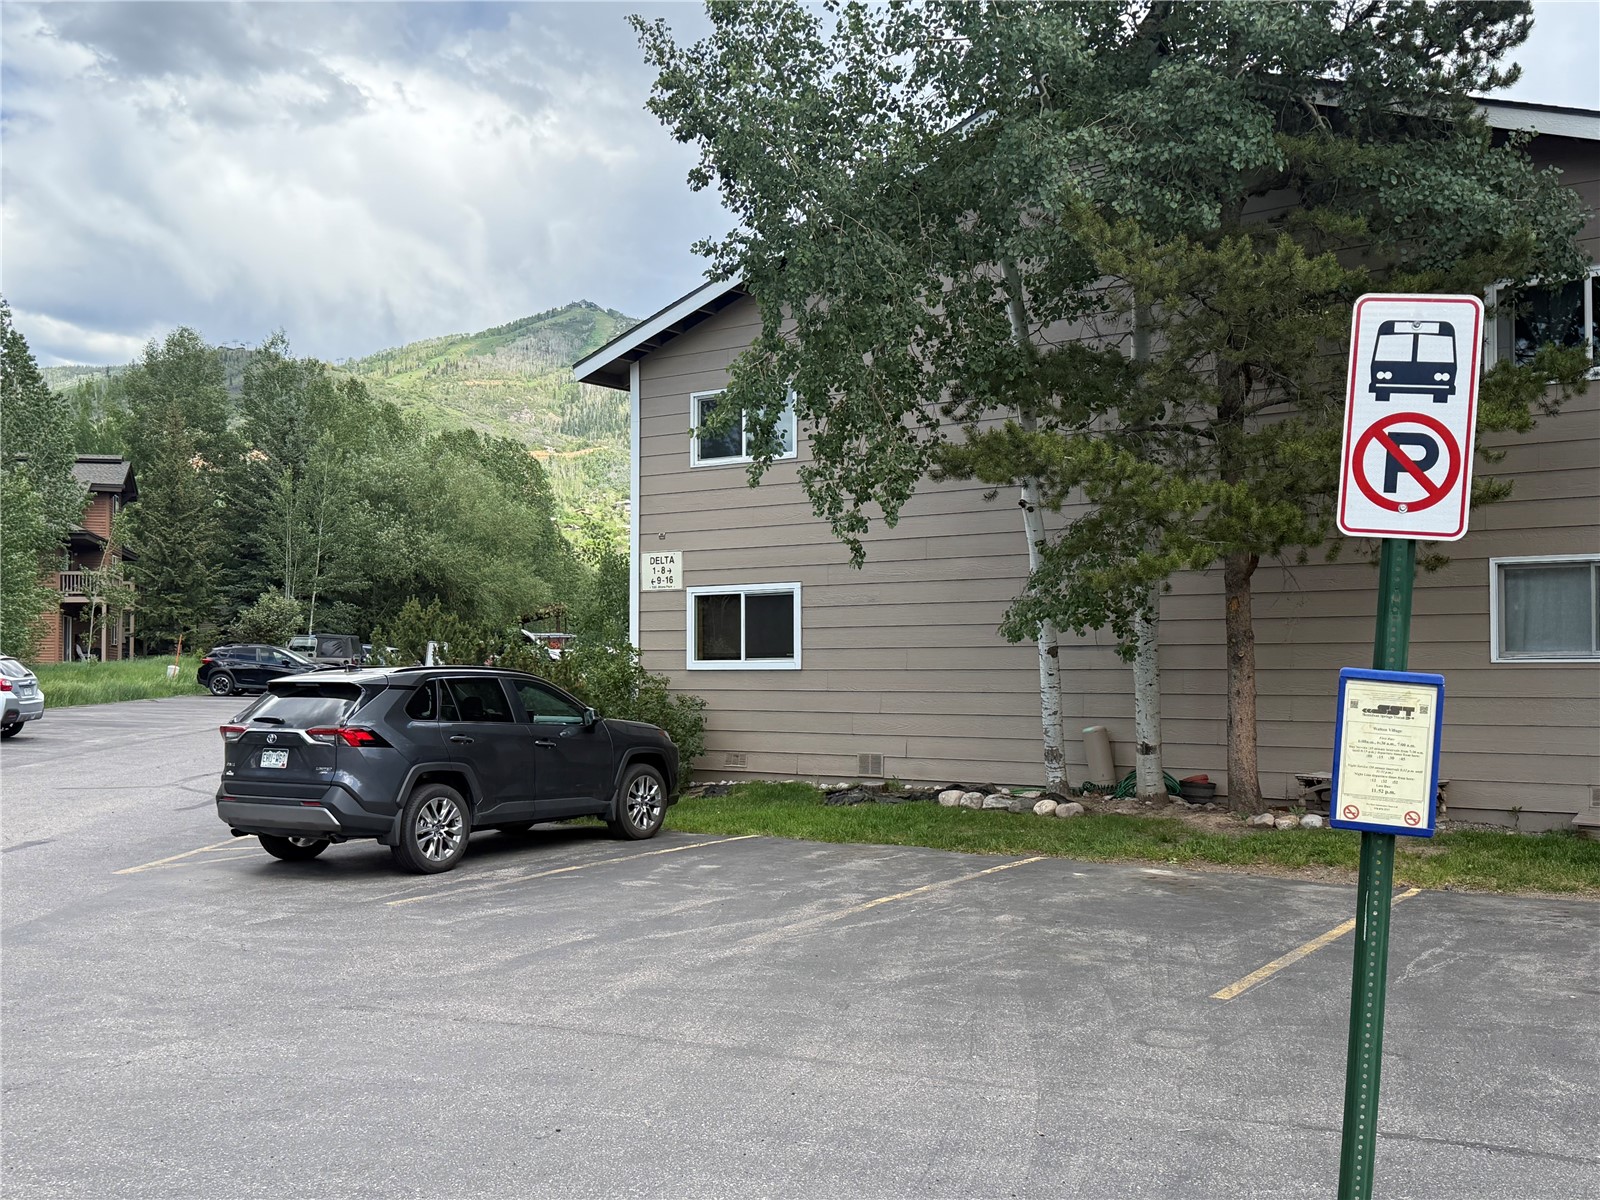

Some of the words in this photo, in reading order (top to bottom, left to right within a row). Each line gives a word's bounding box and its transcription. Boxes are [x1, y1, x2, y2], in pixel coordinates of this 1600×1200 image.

[1383, 431, 1440, 494] P
[649, 556, 675, 565] DELTA
[656, 575, 674, 585] 9-16
